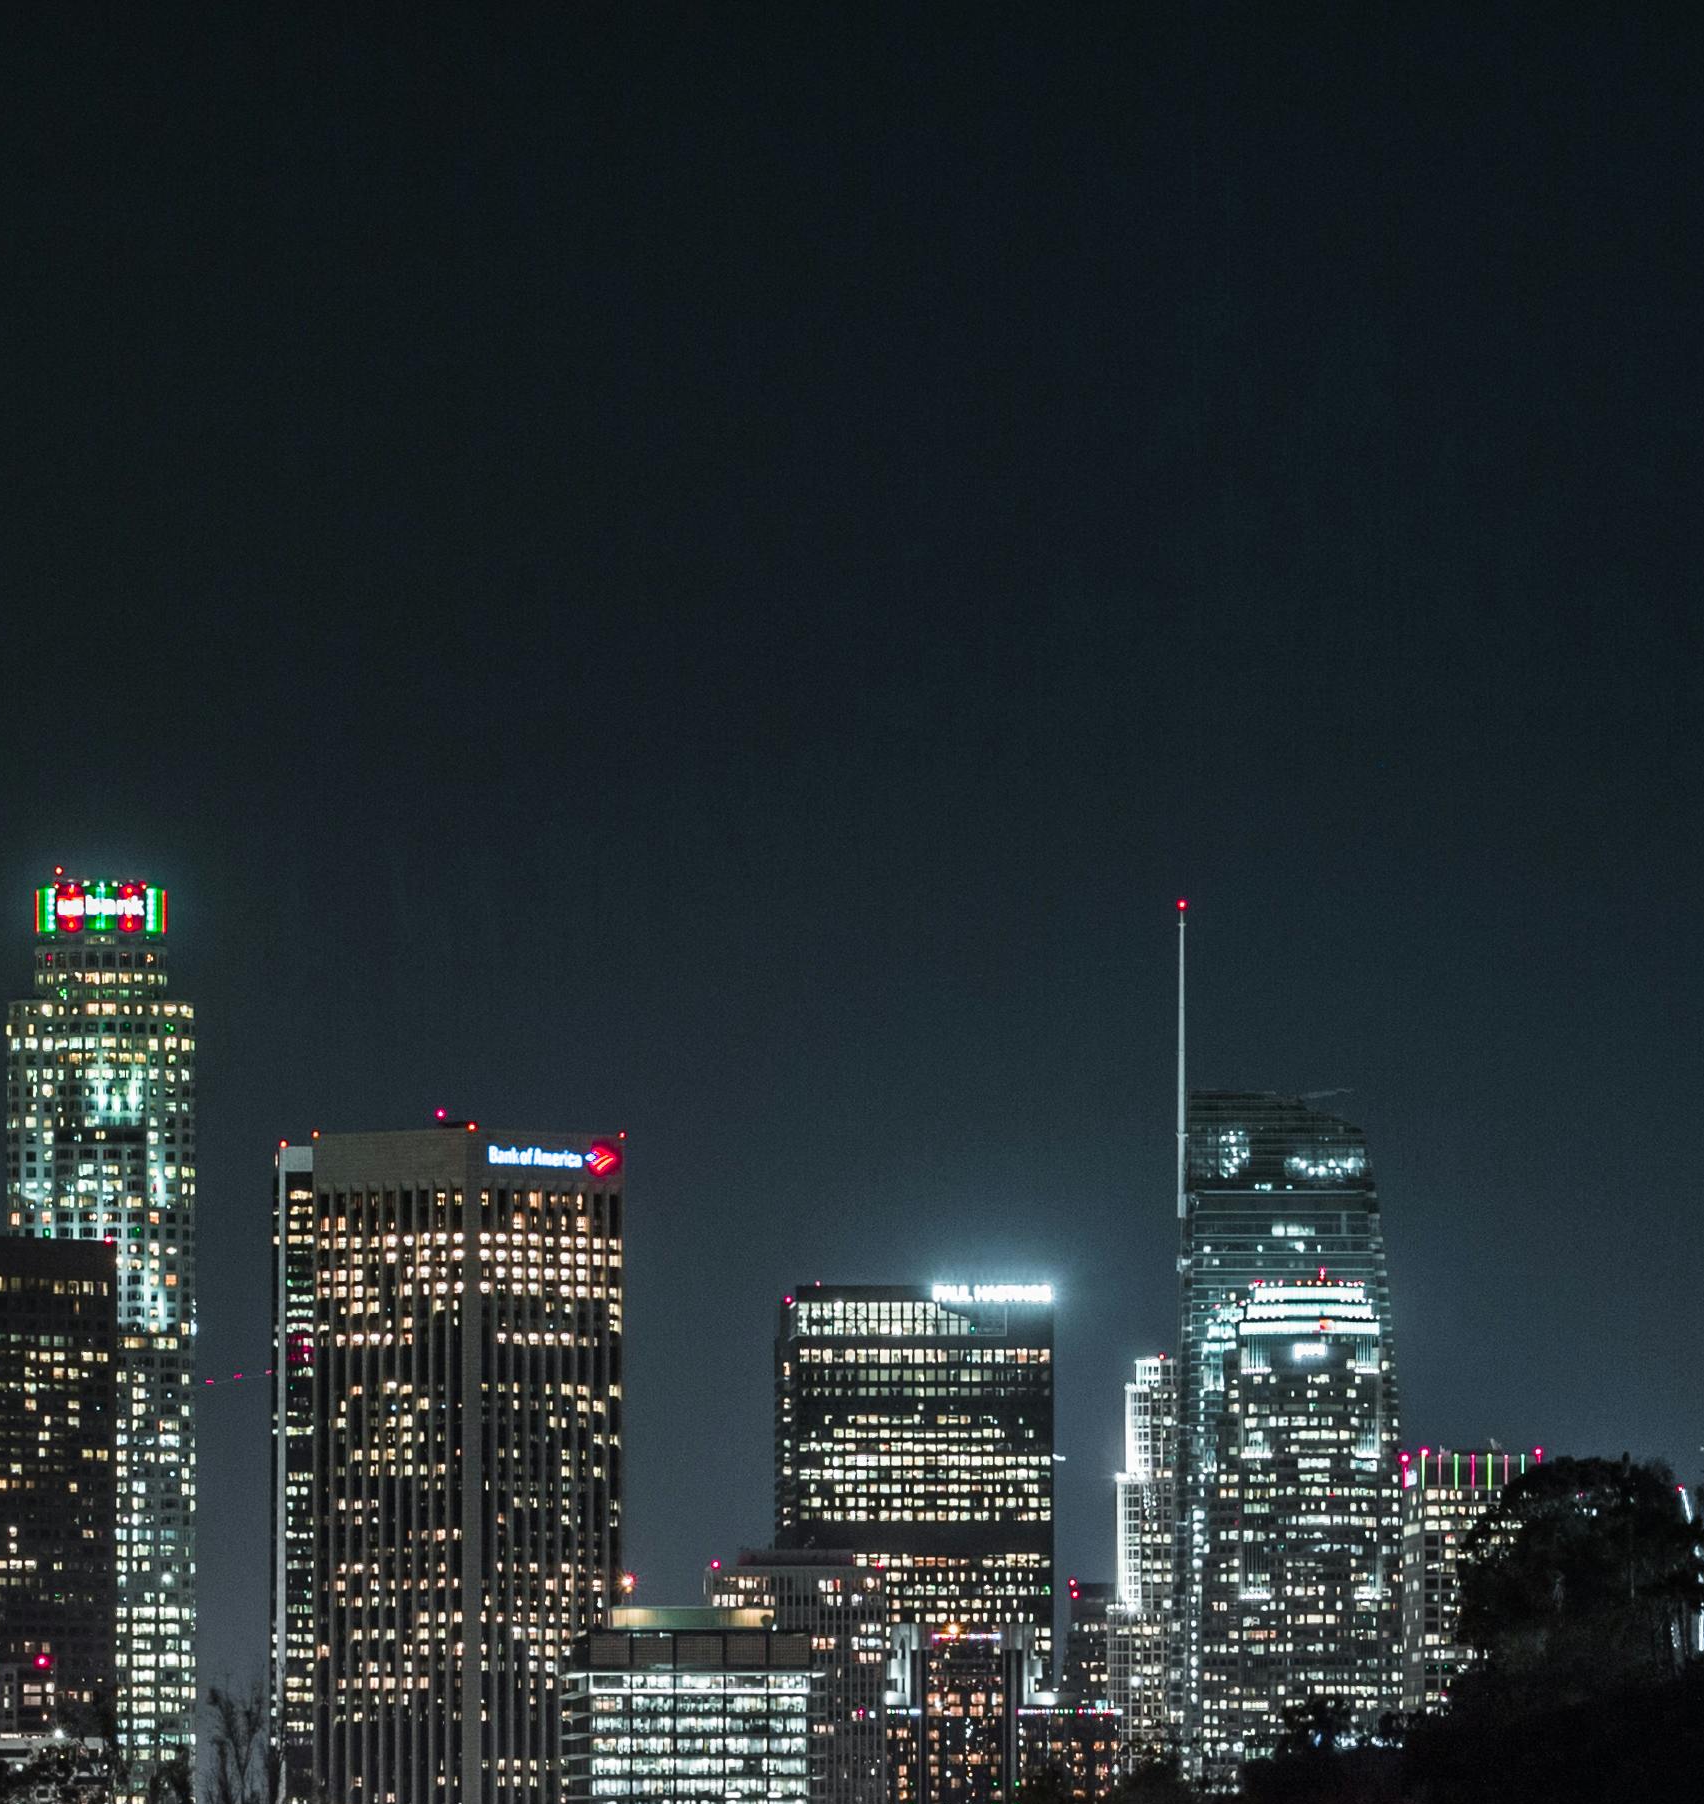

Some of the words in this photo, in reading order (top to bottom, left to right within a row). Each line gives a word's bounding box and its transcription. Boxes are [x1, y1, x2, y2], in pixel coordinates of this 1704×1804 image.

[488, 1145, 519, 1164] Bank
[519, 1147, 533, 1166] of
[533, 1147, 583, 1168] America
